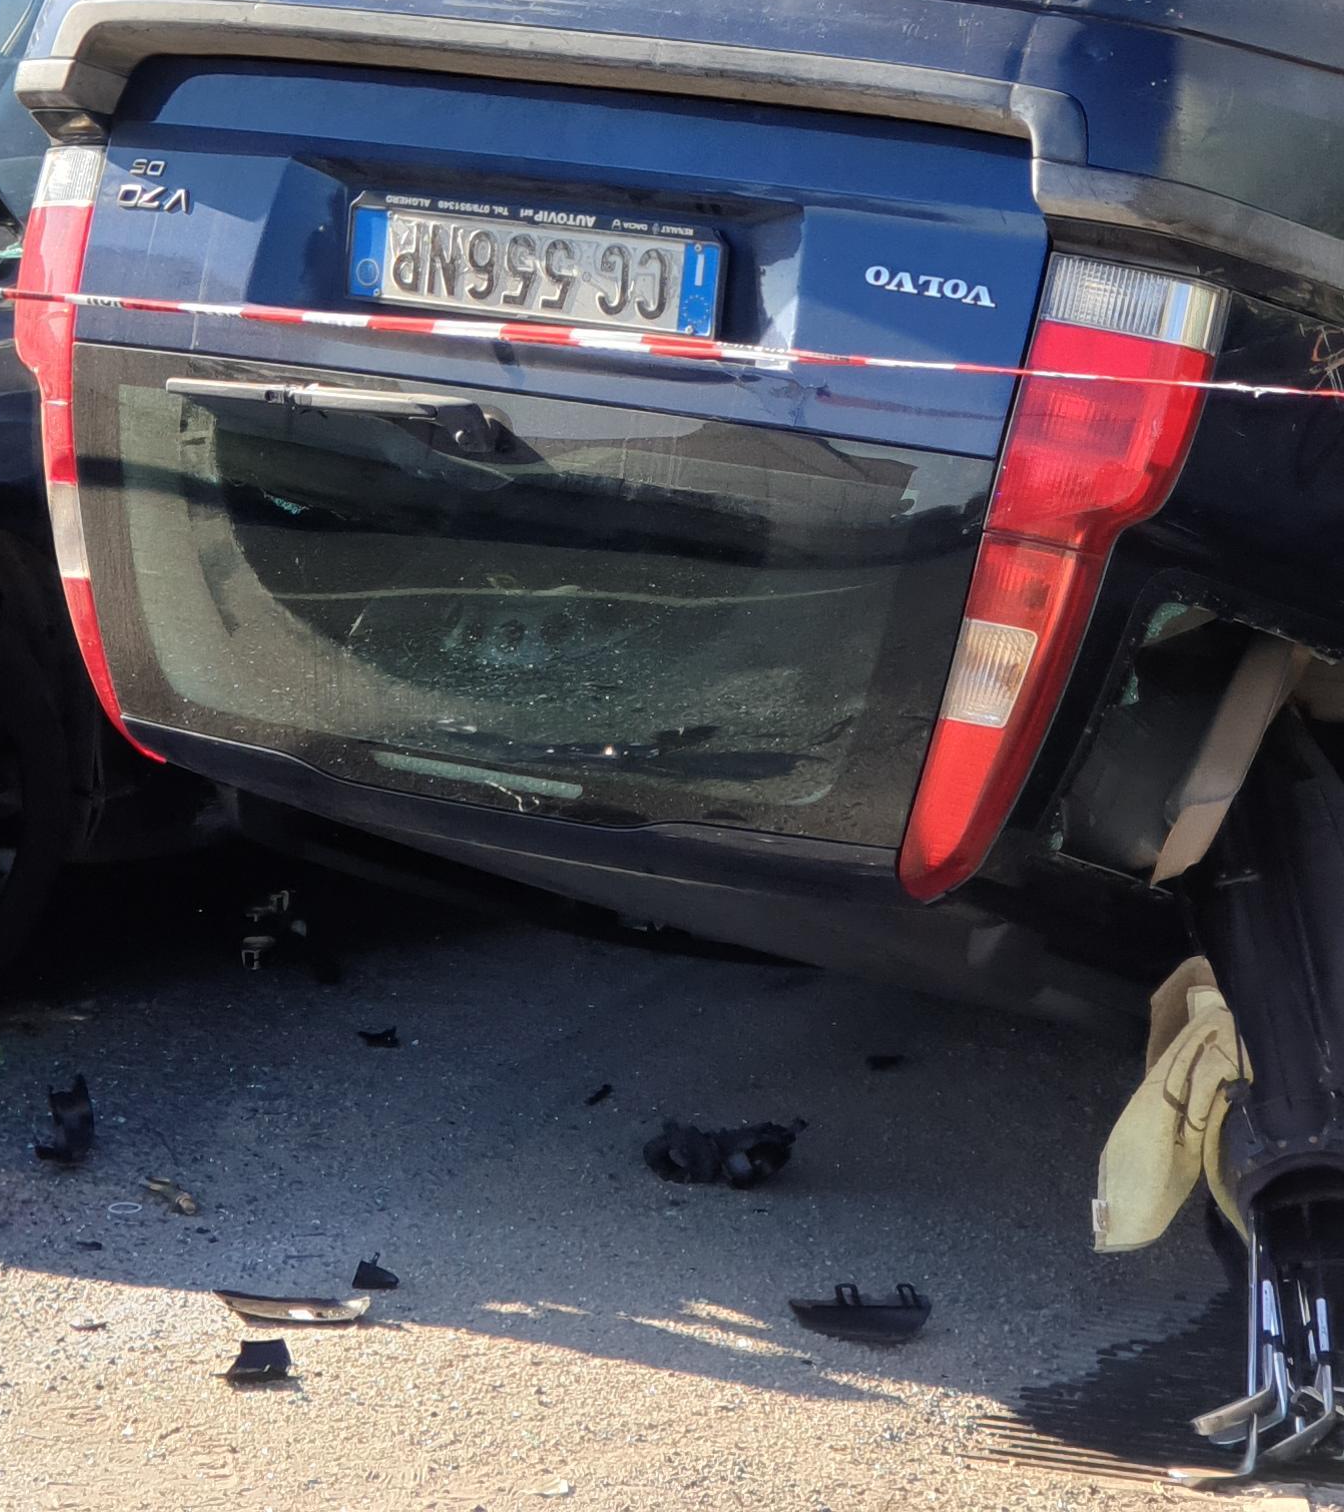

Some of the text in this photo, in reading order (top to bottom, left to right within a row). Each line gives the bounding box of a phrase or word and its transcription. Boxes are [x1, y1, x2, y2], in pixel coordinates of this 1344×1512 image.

[129, 158, 165, 176] D5
[118, 184, 189, 214] V70
[386, 194, 432, 208] ALGHERO
[534, 210, 597, 227] AUTOVIP
[864, 265, 996, 308] VOLVO
